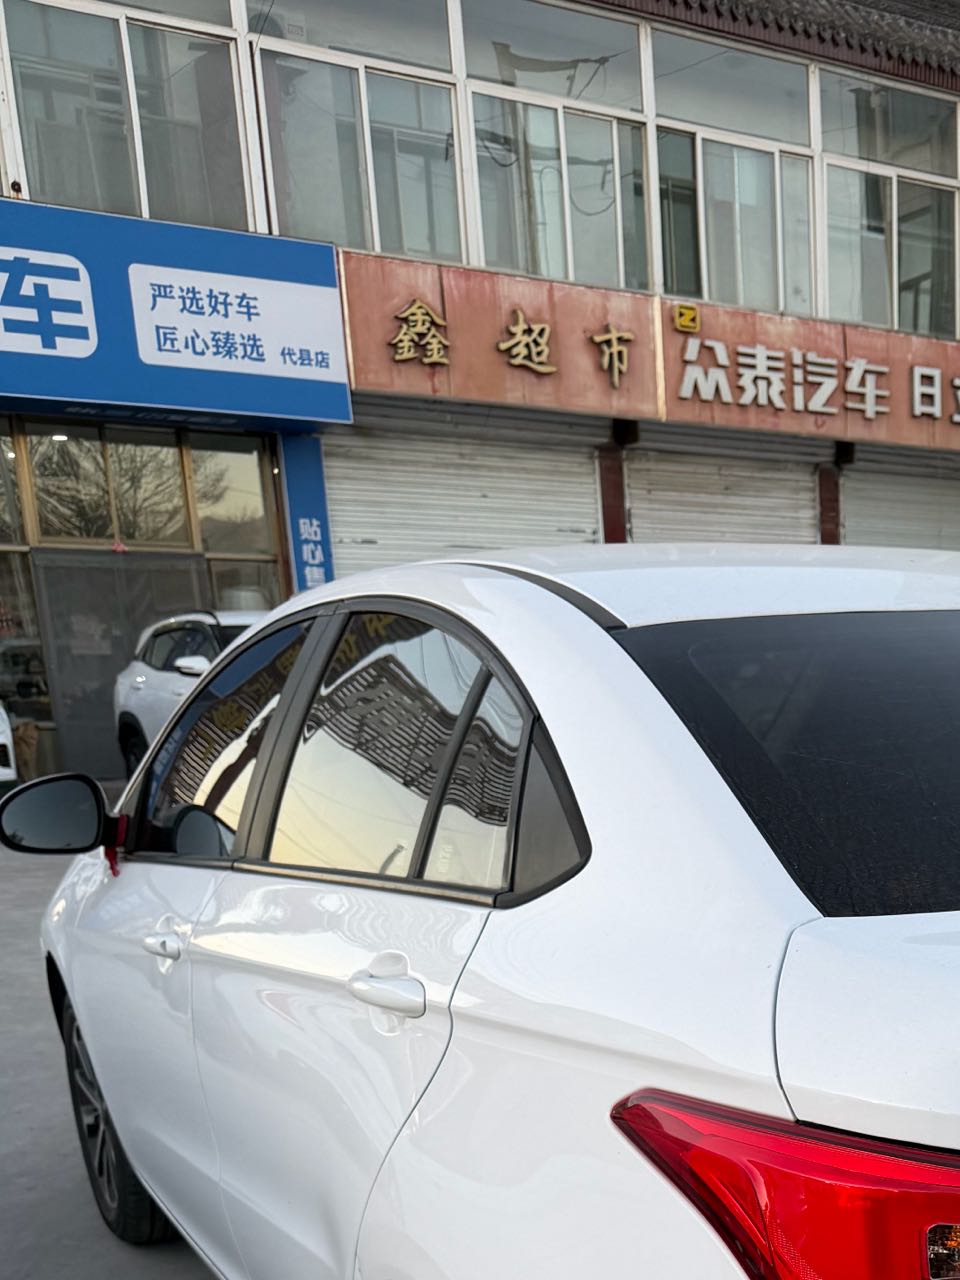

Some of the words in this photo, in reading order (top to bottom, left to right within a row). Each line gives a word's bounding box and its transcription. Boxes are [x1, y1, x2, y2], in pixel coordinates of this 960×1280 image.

[149, 282, 261, 322] 严选好车
[154, 324, 266, 362] 匠心臻选
[280, 346, 330, 369] 代县店
[679, 338, 890, 420] 众泰汽车
